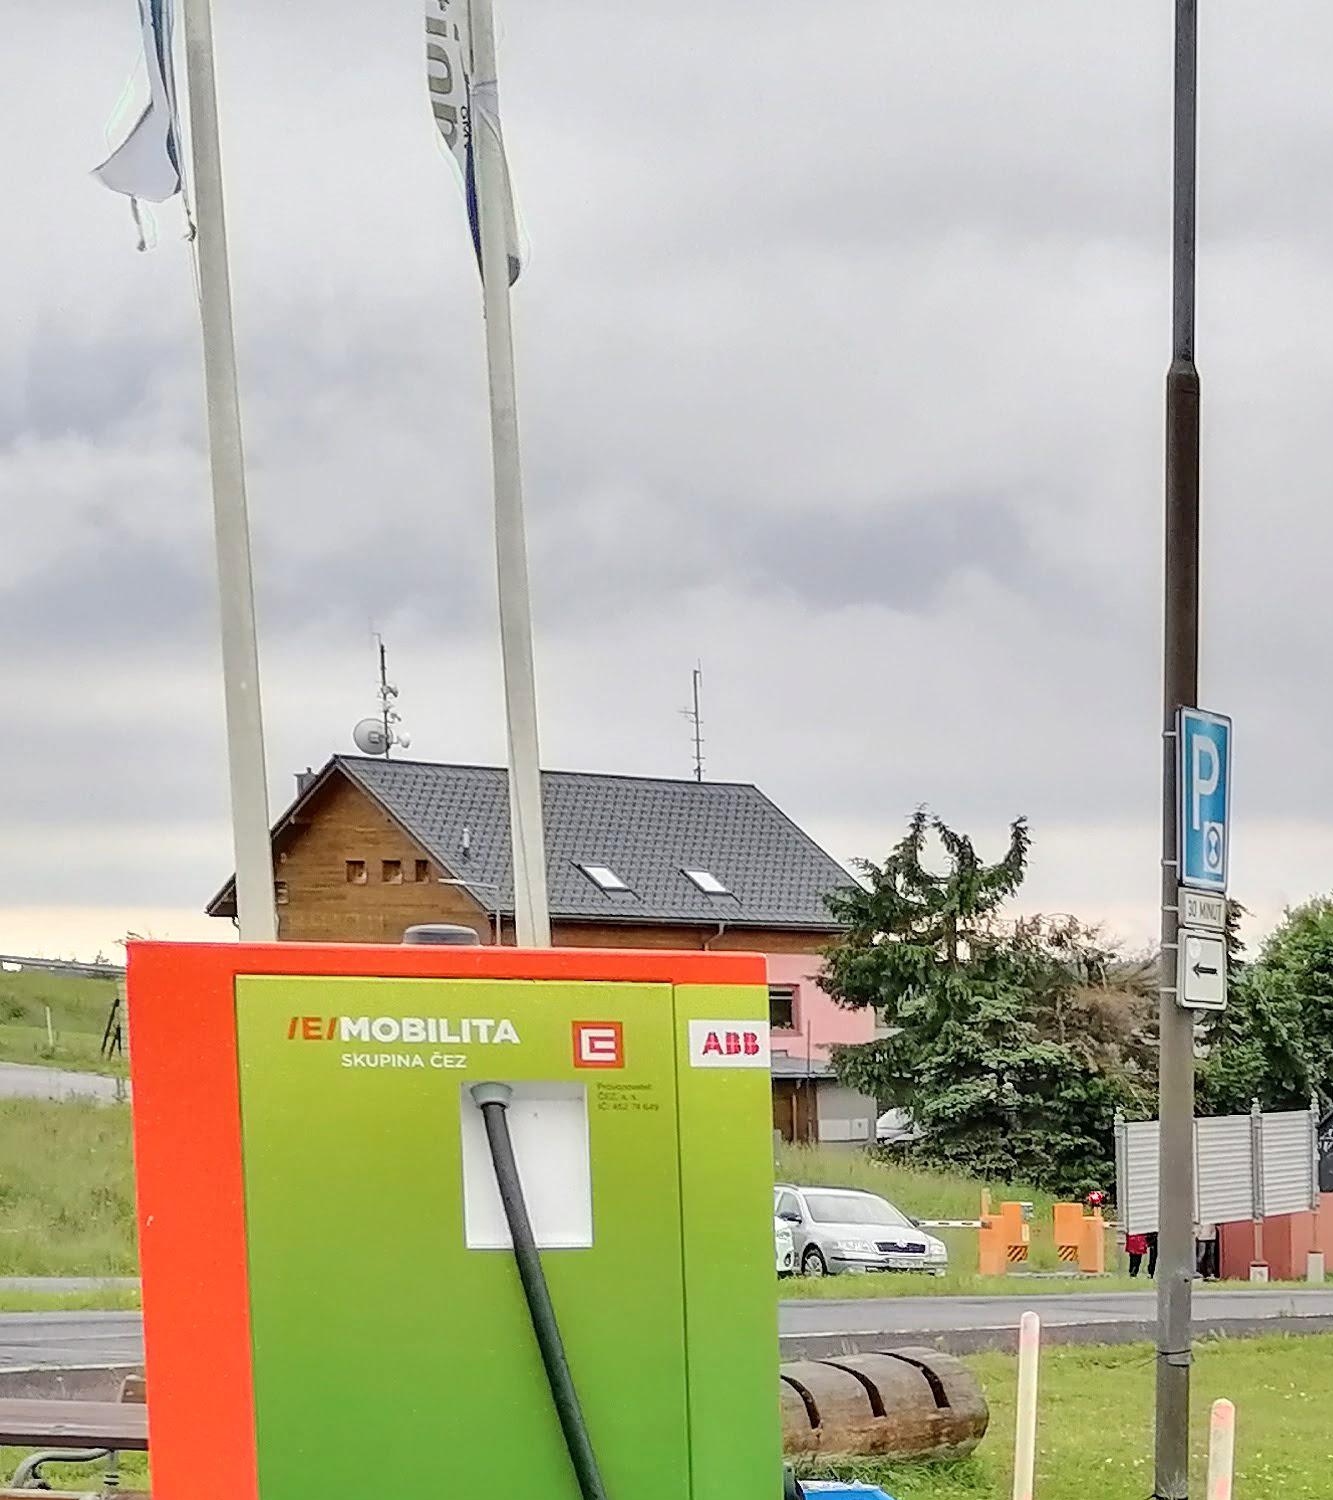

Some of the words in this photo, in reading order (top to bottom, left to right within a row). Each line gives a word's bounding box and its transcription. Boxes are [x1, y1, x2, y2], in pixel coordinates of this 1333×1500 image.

[1192, 733, 1219, 831] P
[702, 1031, 760, 1056] ABB
[341, 1053, 425, 1068] SKUPINA
[430, 1050, 468, 1069] ČEZ
